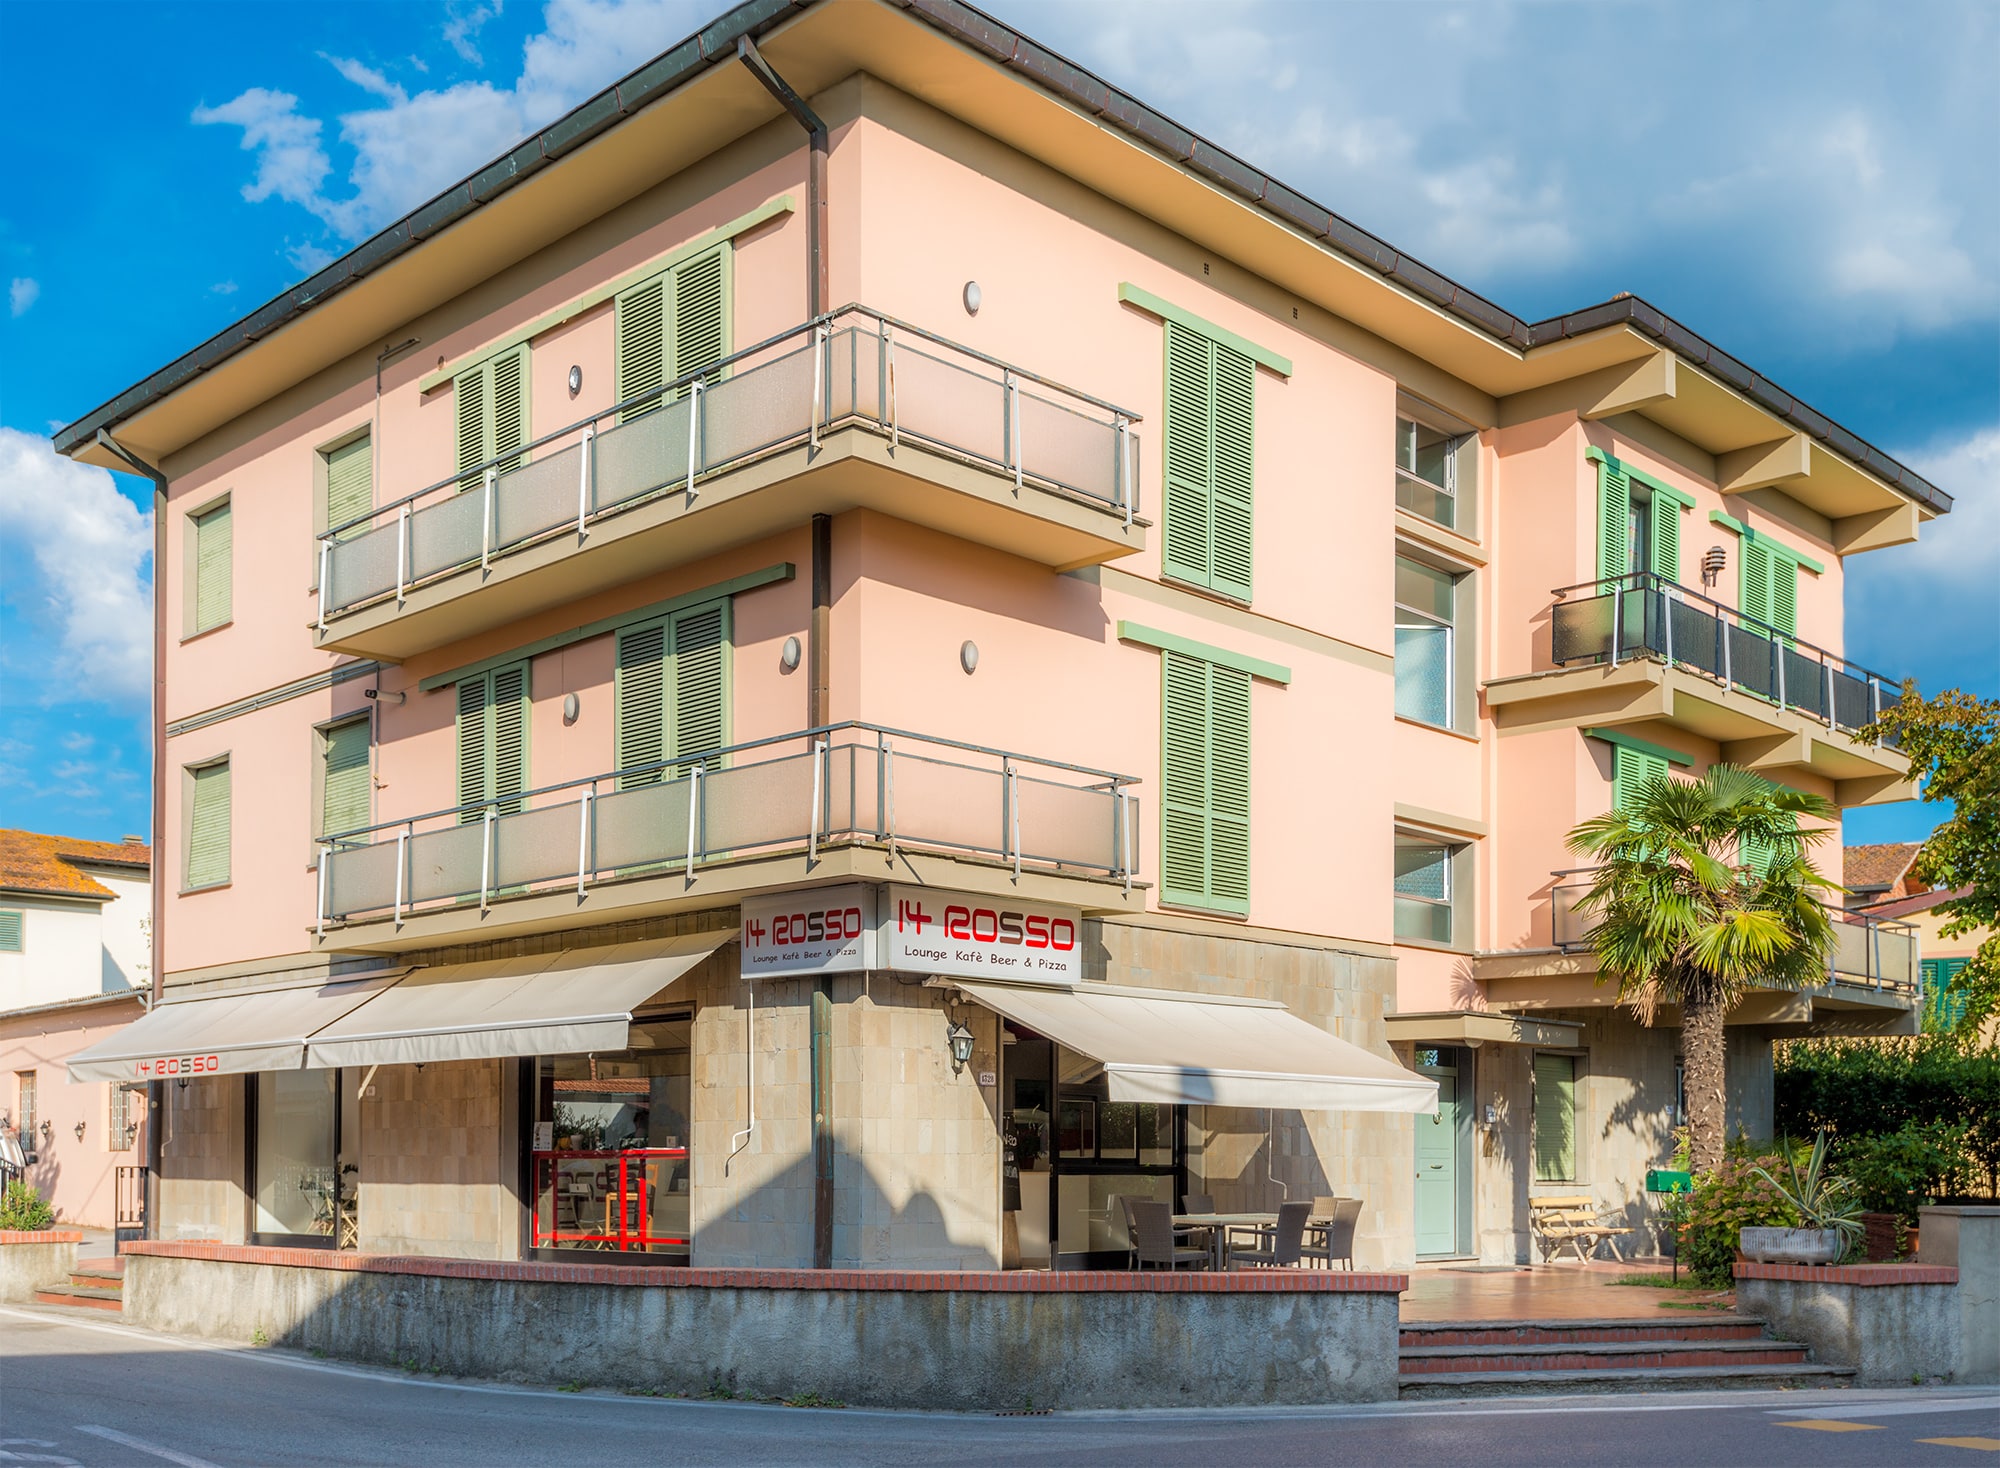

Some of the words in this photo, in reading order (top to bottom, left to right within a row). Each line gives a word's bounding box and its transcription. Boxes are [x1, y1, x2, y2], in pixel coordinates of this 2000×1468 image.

[745, 918, 766, 949] 14
[772, 907, 861, 946] ROSSO
[898, 898, 933, 935] 14
[944, 904, 1075, 951] ROSSO
[753, 955, 778, 964] Lounge
[782, 952, 800, 961] Kafè
[804, 951, 822, 959] Beer
[826, 949, 832, 957] &
[835, 948, 857, 956] Pizza
[904, 945, 948, 961] Lounge
[955, 950, 983, 963] Kafè
[990, 953, 1018, 966] Beer
[1024, 957, 1032, 968] &
[1038, 958, 1067, 971] Pizza
[135, 1061, 151, 1077] 14
[155, 1055, 219, 1075] ROSSO
